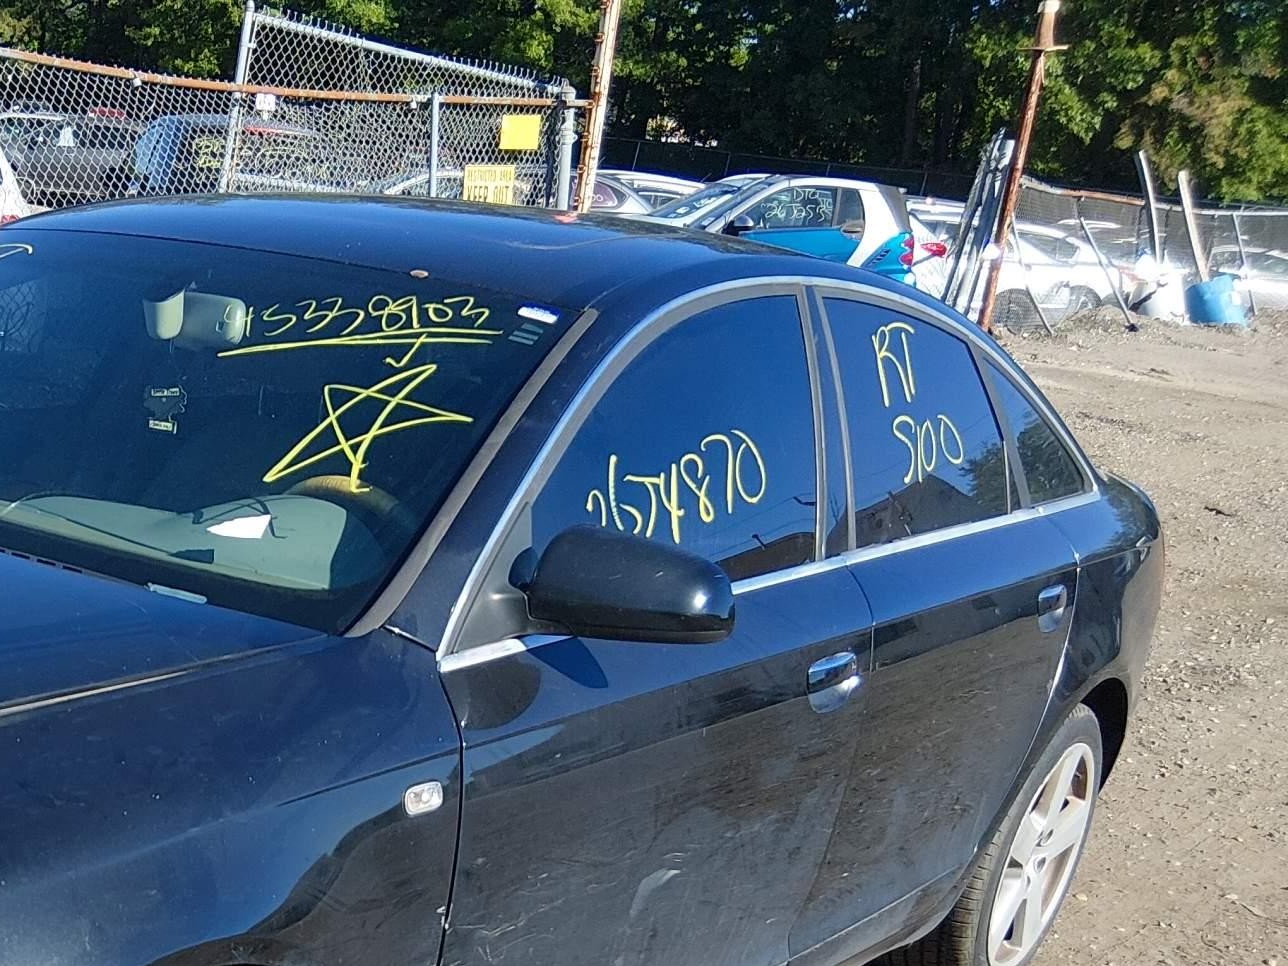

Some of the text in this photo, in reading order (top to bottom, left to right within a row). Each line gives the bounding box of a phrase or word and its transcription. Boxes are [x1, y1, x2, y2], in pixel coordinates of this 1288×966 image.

[467, 185, 510, 203] KEEP OUT
[223, 295, 490, 336] 45338903
[872, 322, 915, 408] RT
[893, 415, 963, 484] S100
